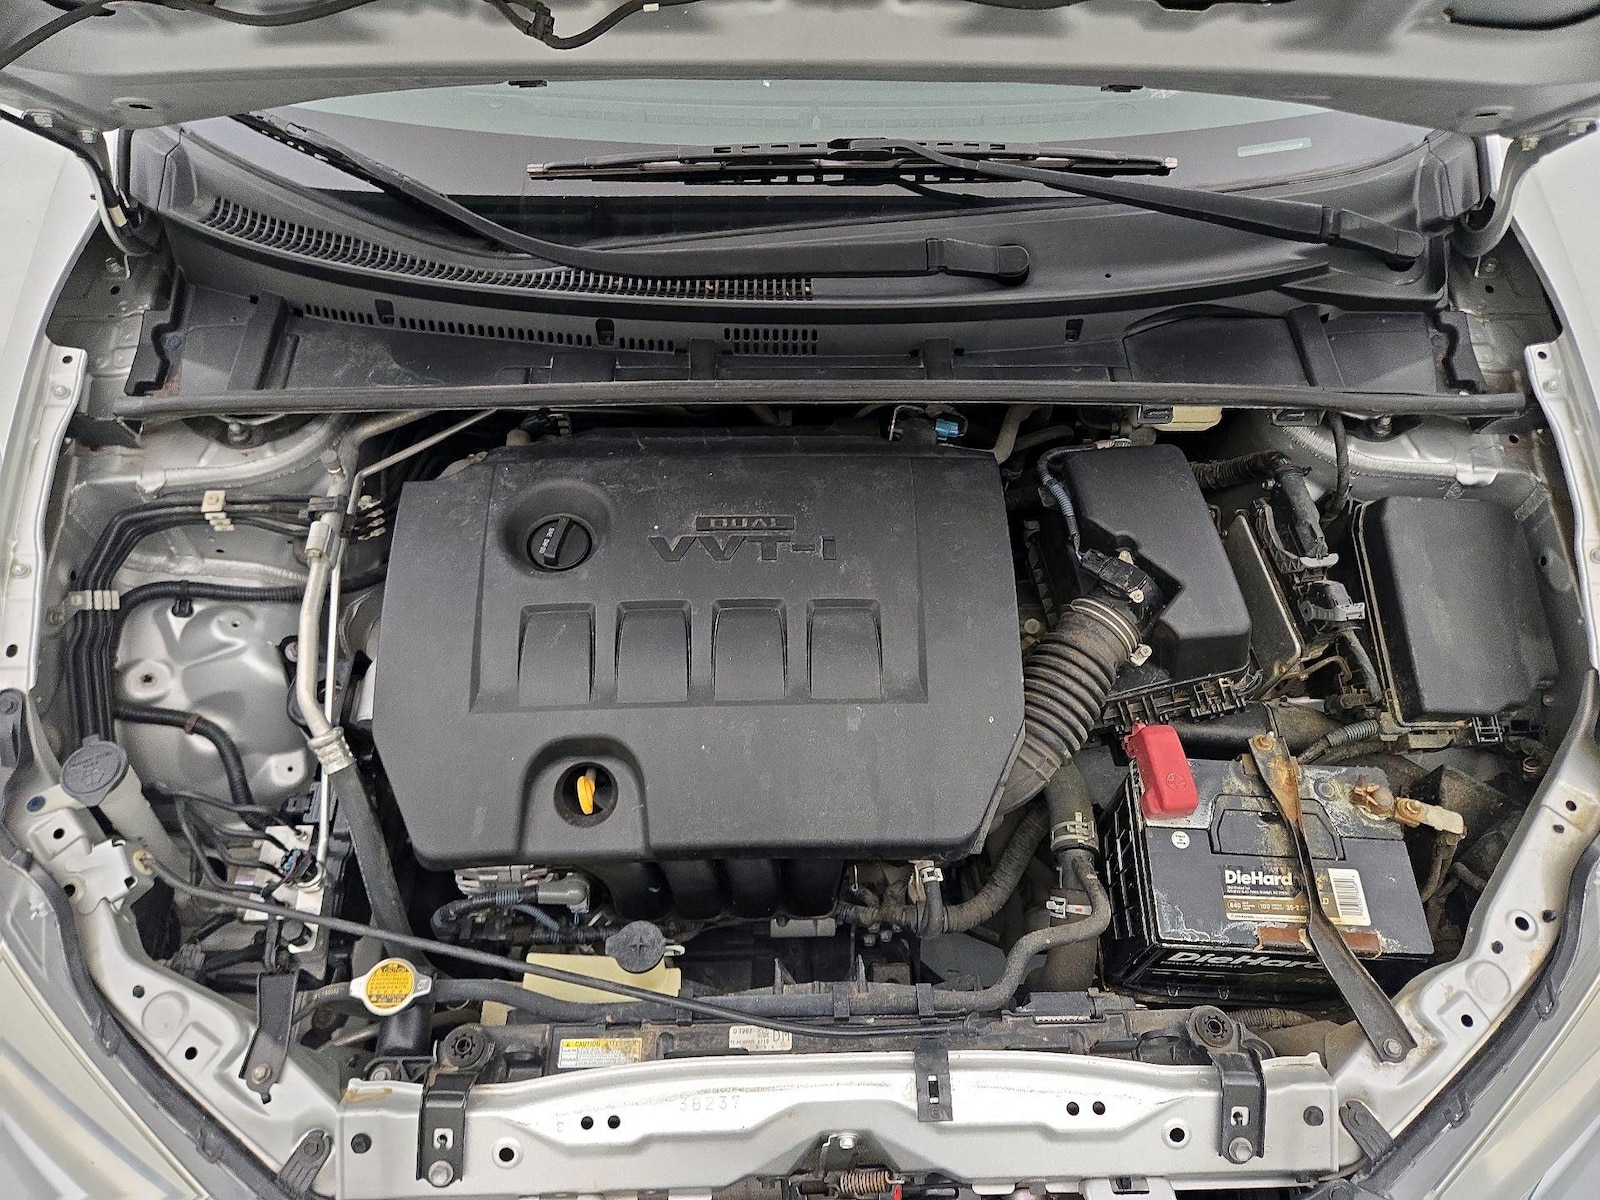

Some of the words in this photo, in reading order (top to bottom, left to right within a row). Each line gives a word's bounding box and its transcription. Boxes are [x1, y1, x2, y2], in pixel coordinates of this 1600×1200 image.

[710, 517, 785, 528] DUAL
[1224, 869, 1293, 886] DieHard
[1260, 902, 1271, 911] 100
